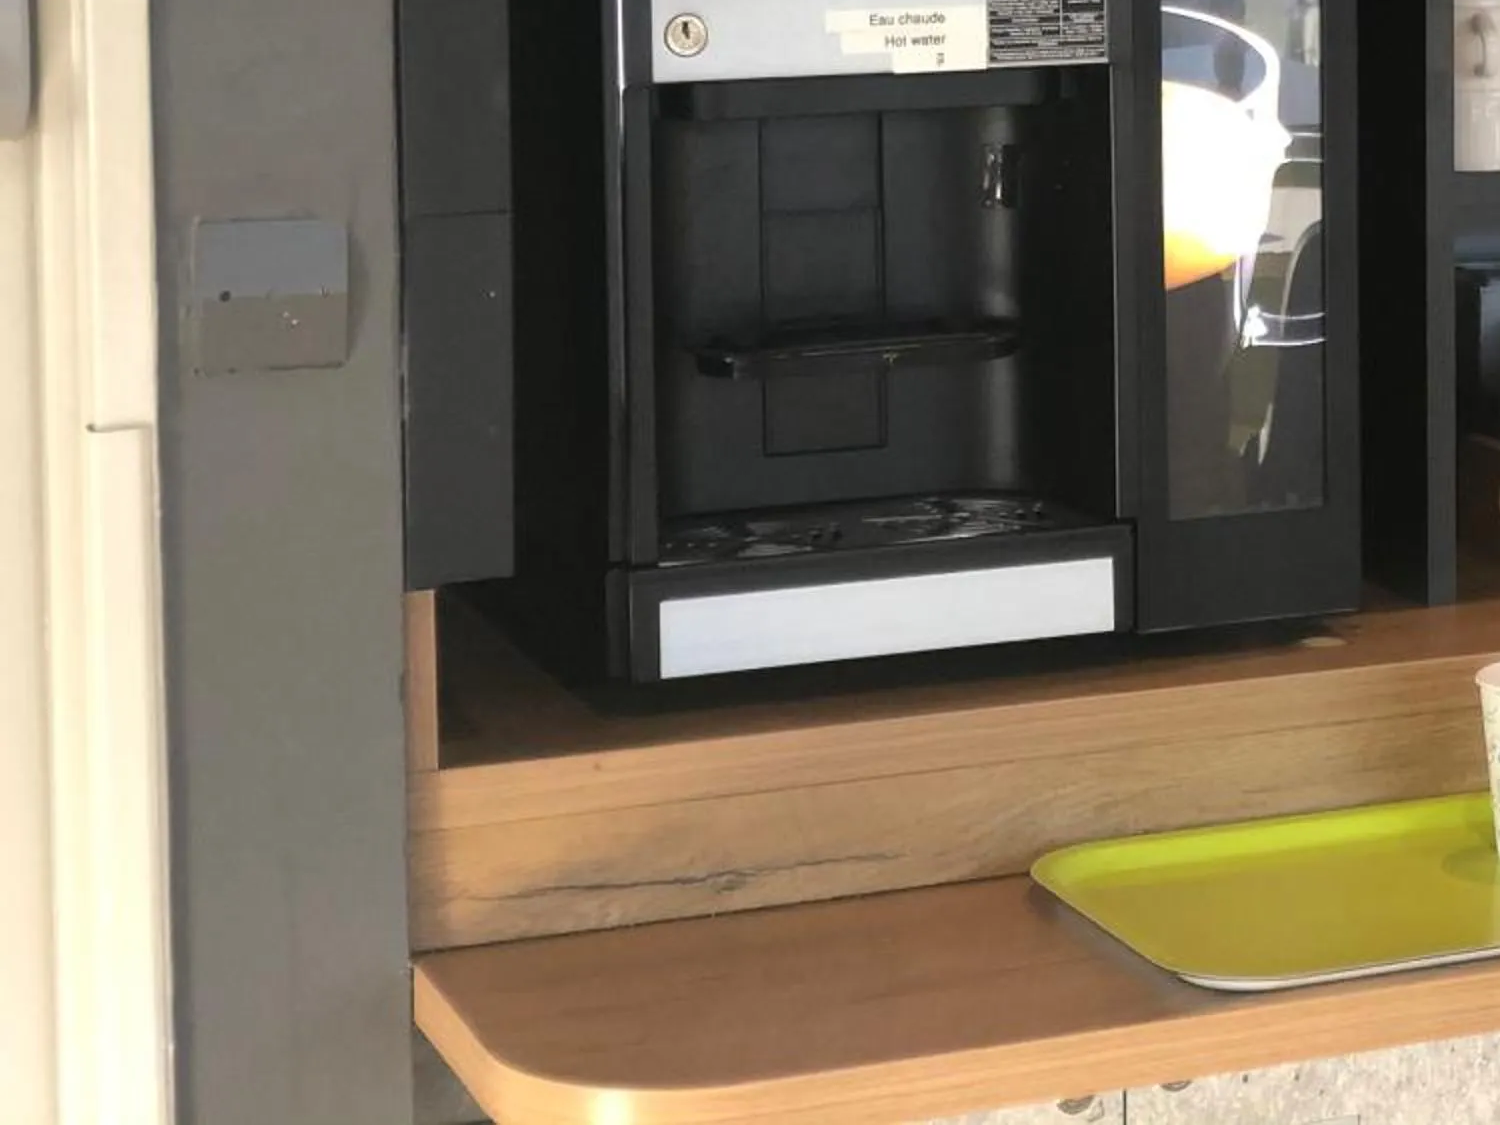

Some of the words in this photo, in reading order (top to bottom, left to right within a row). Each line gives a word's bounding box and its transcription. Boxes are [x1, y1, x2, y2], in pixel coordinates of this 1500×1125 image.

[868, 13, 895, 26] Eau
[898, 11, 946, 25] chaude
[884, 34, 907, 48] Hot
[910, 33, 946, 46] water
